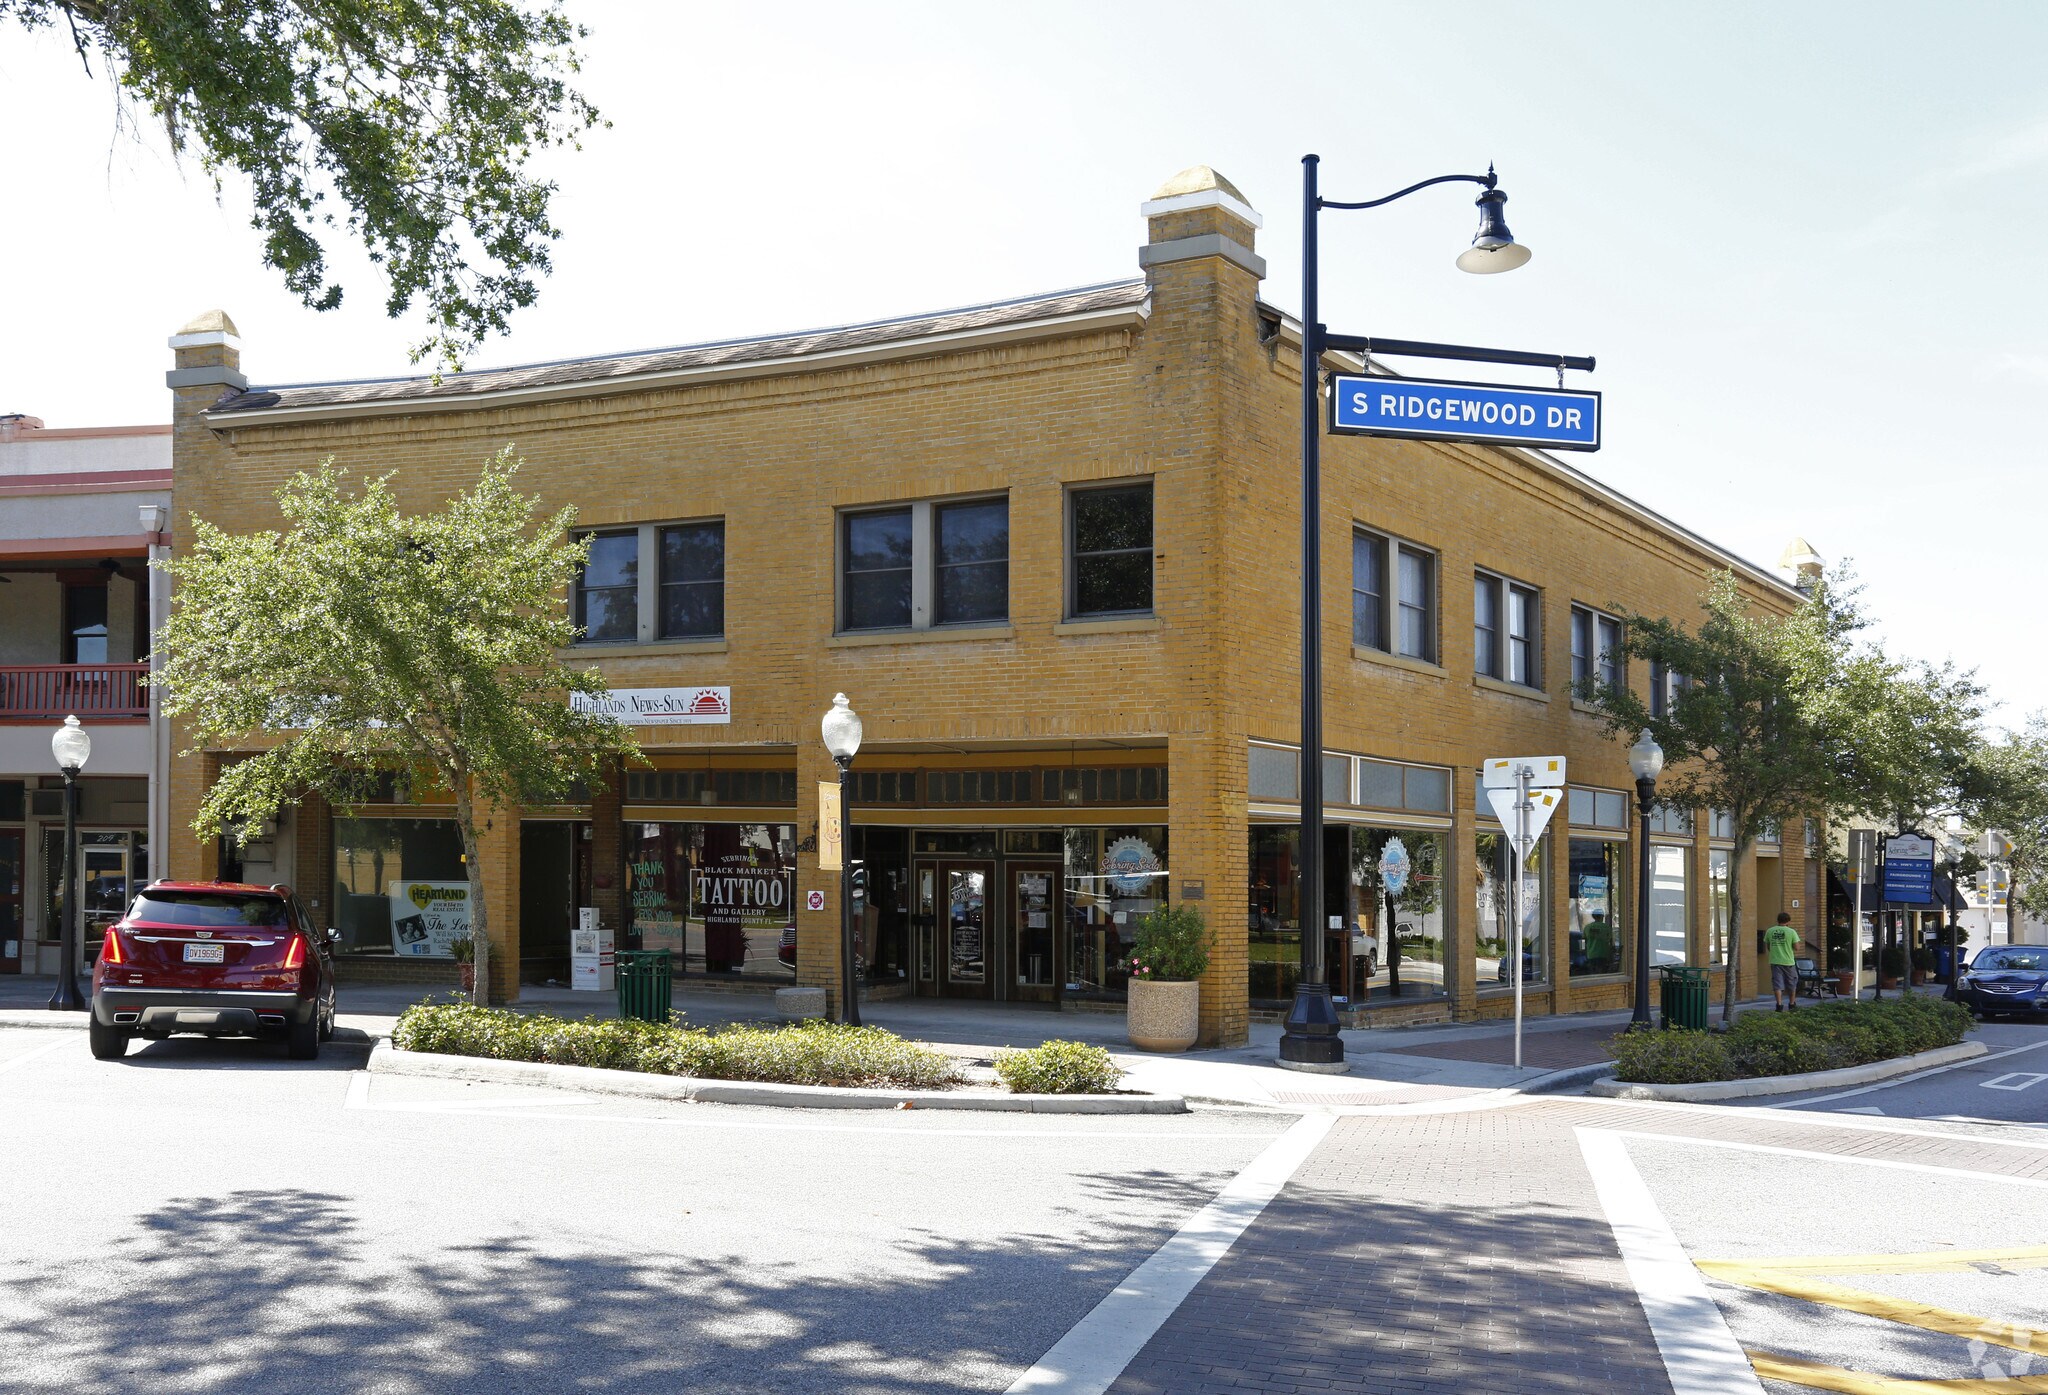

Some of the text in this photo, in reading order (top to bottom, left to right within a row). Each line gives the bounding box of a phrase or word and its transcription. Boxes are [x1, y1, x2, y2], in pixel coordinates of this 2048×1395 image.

[1352, 392, 1581, 430] S RIDGEWOOD DR
[632, 861, 665, 876] THANK
[1100, 857, 1160, 874] Sebring Soda
[637, 877, 654, 890] YOU
[412, 887, 466, 903] HEARTLAND
[632, 890, 667, 908] SEBRING
[697, 877, 783, 907] TATTOO
[639, 909, 673, 922] FOR YOUR
[731, 908, 766, 916] GALLERY
[427, 918, 447, 931] The
[707, 916, 740, 924] HIGHLANDS
